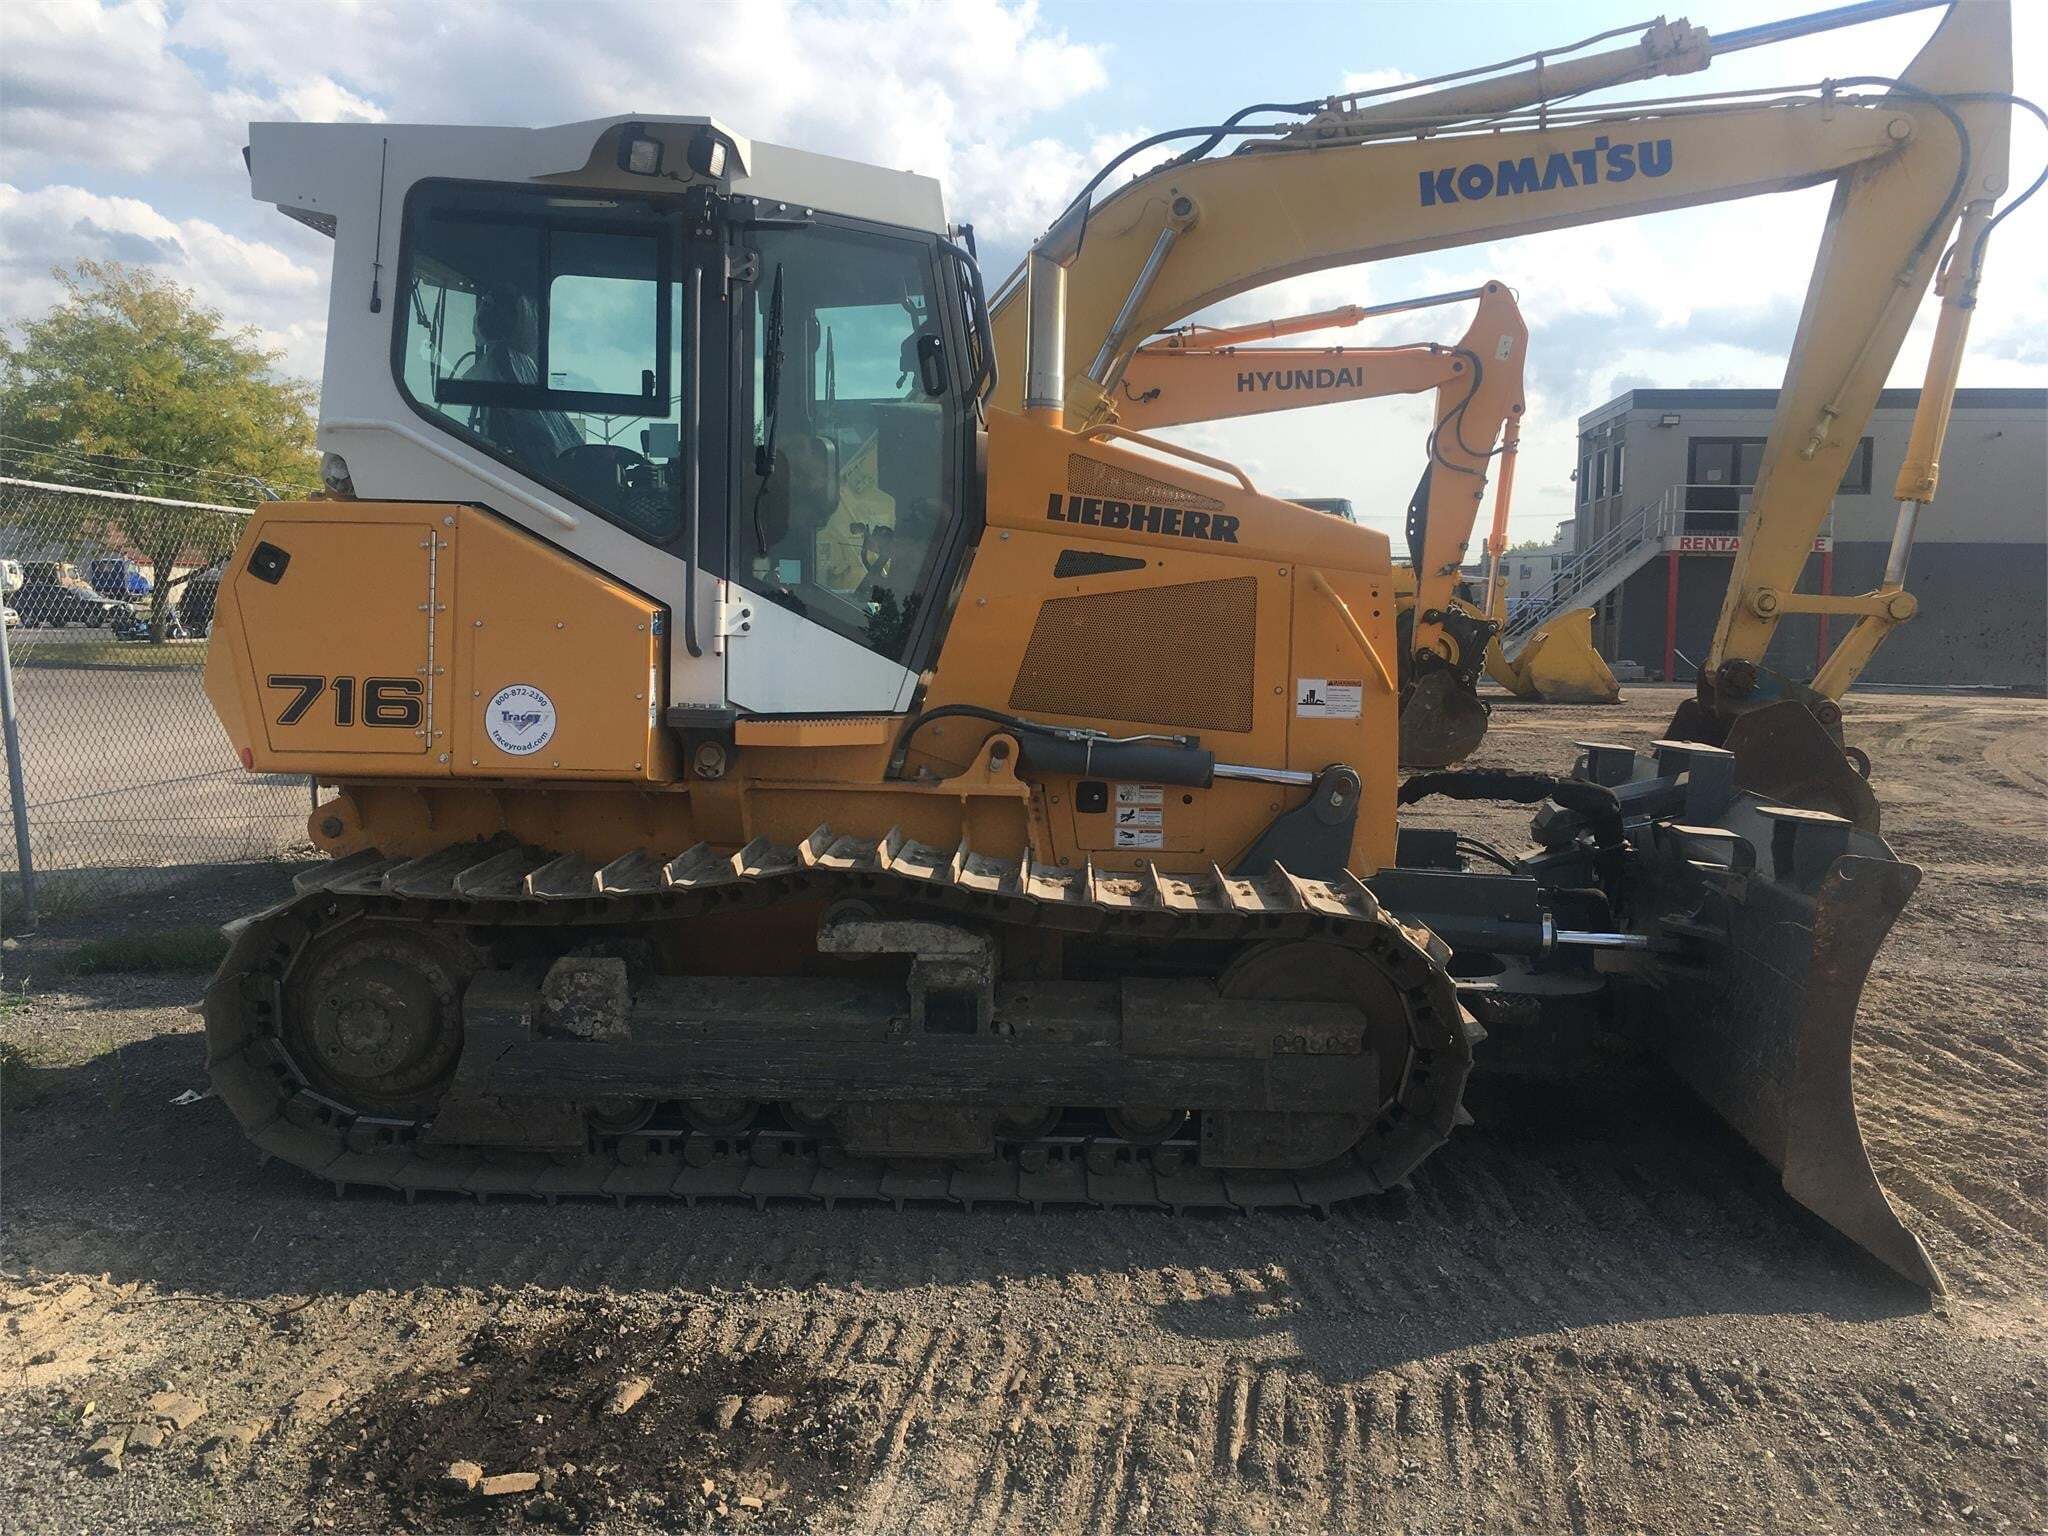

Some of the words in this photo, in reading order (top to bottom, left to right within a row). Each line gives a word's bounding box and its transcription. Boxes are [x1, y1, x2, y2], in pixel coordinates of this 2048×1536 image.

[1419, 136, 1672, 206] KOMATSU
[1237, 367, 1363, 392] HYUNDAI
[1047, 493, 1240, 543] LIEBHERR
[1680, 537, 1741, 550] RENTA
[267, 674, 424, 728] 716
[495, 688, 548, 706] 800-872-2390
[502, 711, 541, 724] Tracey
[493, 730, 548, 751] traceyroad.com
